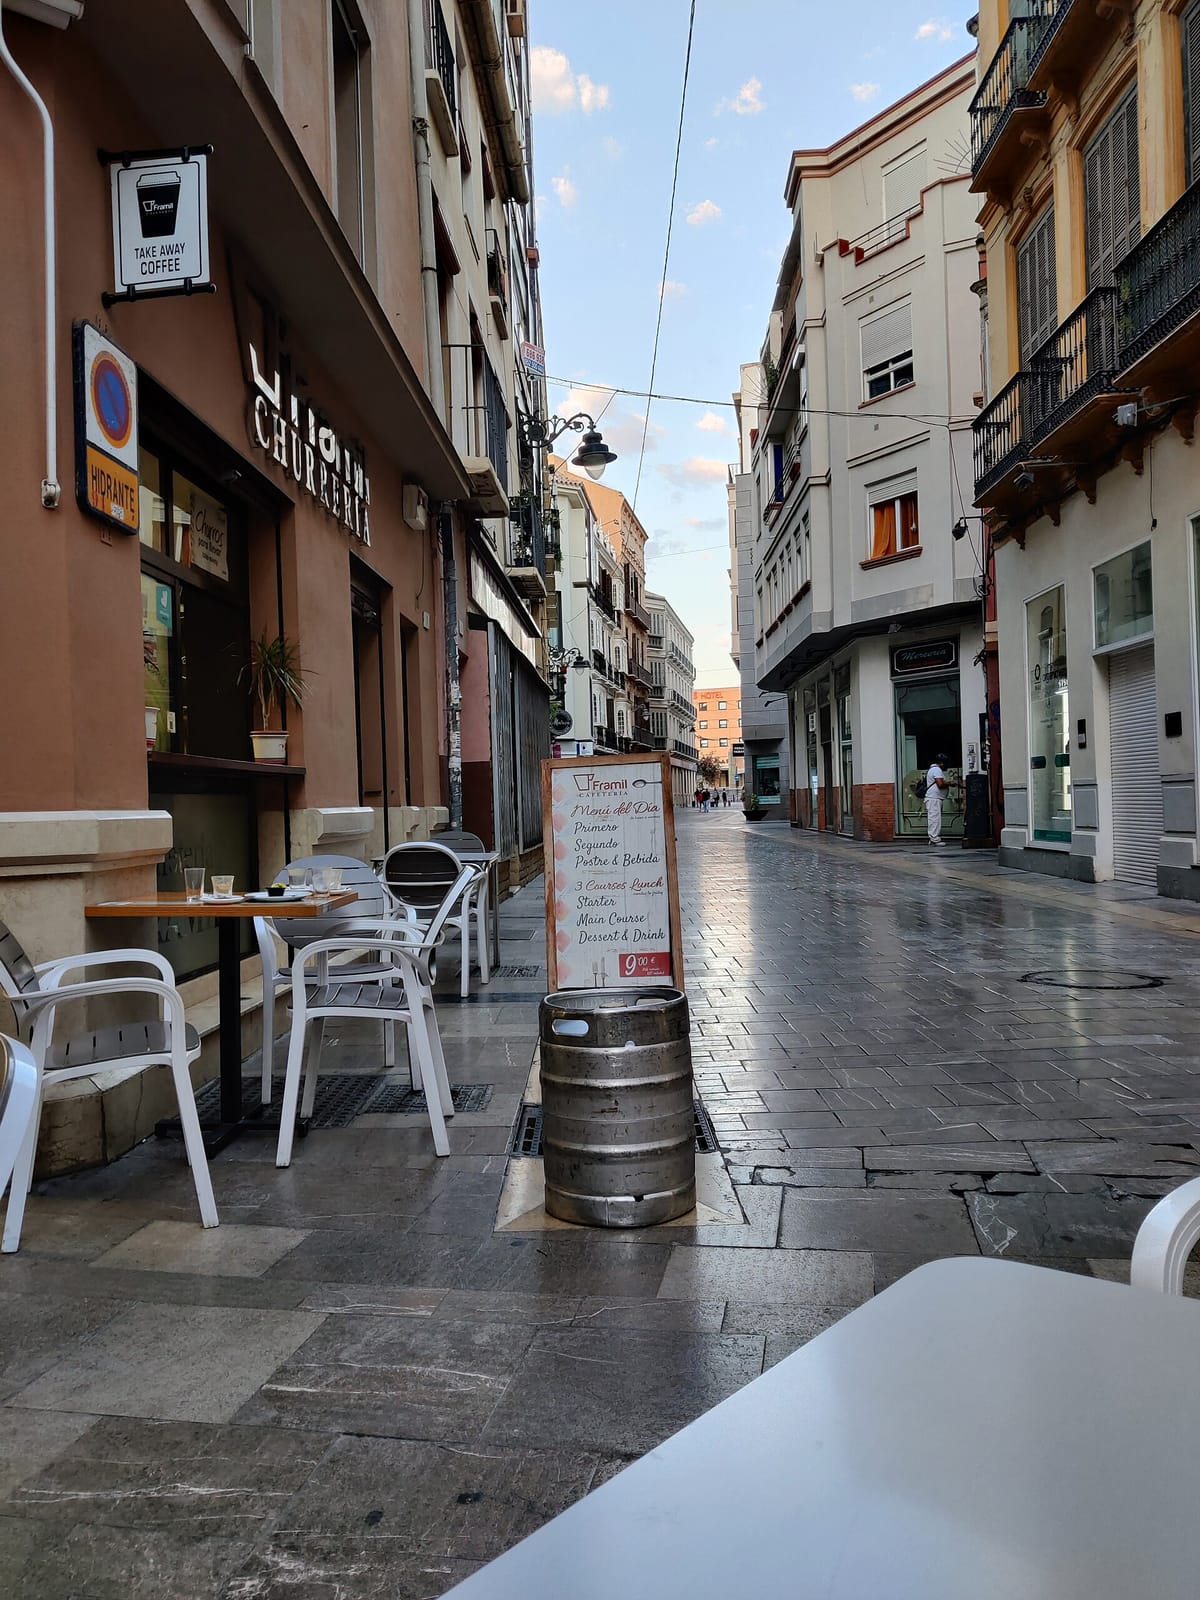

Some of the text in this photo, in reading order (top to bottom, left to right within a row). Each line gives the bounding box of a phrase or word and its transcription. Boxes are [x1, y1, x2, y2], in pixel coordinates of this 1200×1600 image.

[134, 242, 186, 259] TAKE AWAY
[140, 257, 181, 275] COFFEE
[91, 464, 135, 514] HIDRANTE
[195, 508, 225, 547] Churros
[701, 691, 724, 700] HOTEL
[592, 779, 628, 791] Framil
[570, 800, 661, 818] Menú del Día
[573, 821, 619, 835] Primero
[574, 837, 620, 855] Segundo
[575, 852, 661, 869] Postre & Bebida
[574, 876, 664, 892] 3 Courses Lunch
[576, 895, 617, 909] Starter
[576, 911, 647, 927] Main Course
[578, 928, 666, 944] Dessert & Drink
